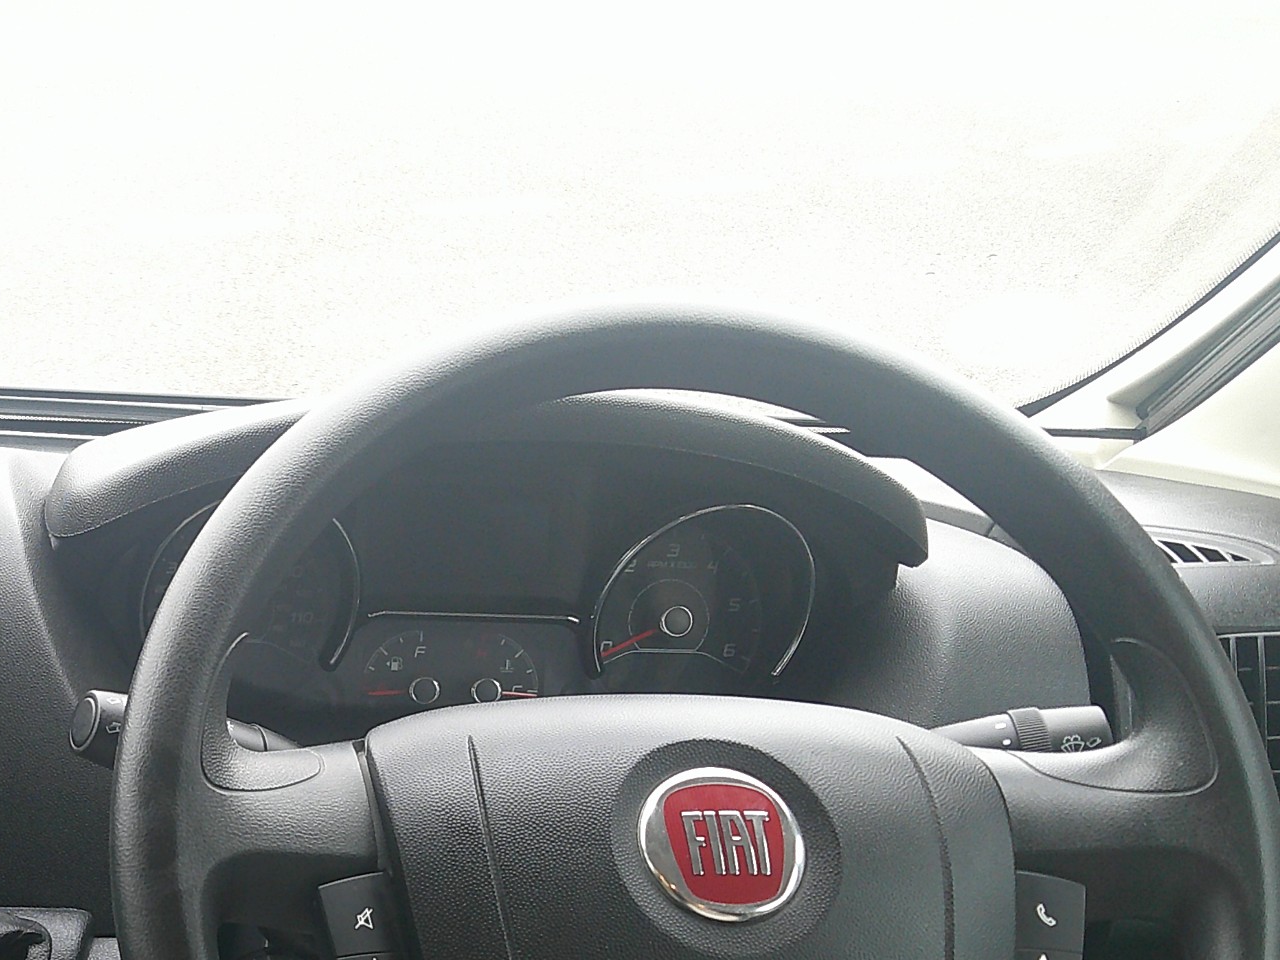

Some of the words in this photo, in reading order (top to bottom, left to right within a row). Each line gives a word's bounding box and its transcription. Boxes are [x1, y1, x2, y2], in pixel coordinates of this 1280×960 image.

[666, 544, 681, 558] 3
[727, 597, 741, 612] 5
[413, 645, 427, 658] F
[722, 643, 736, 658] 6
[680, 810, 772, 876] FIAT
